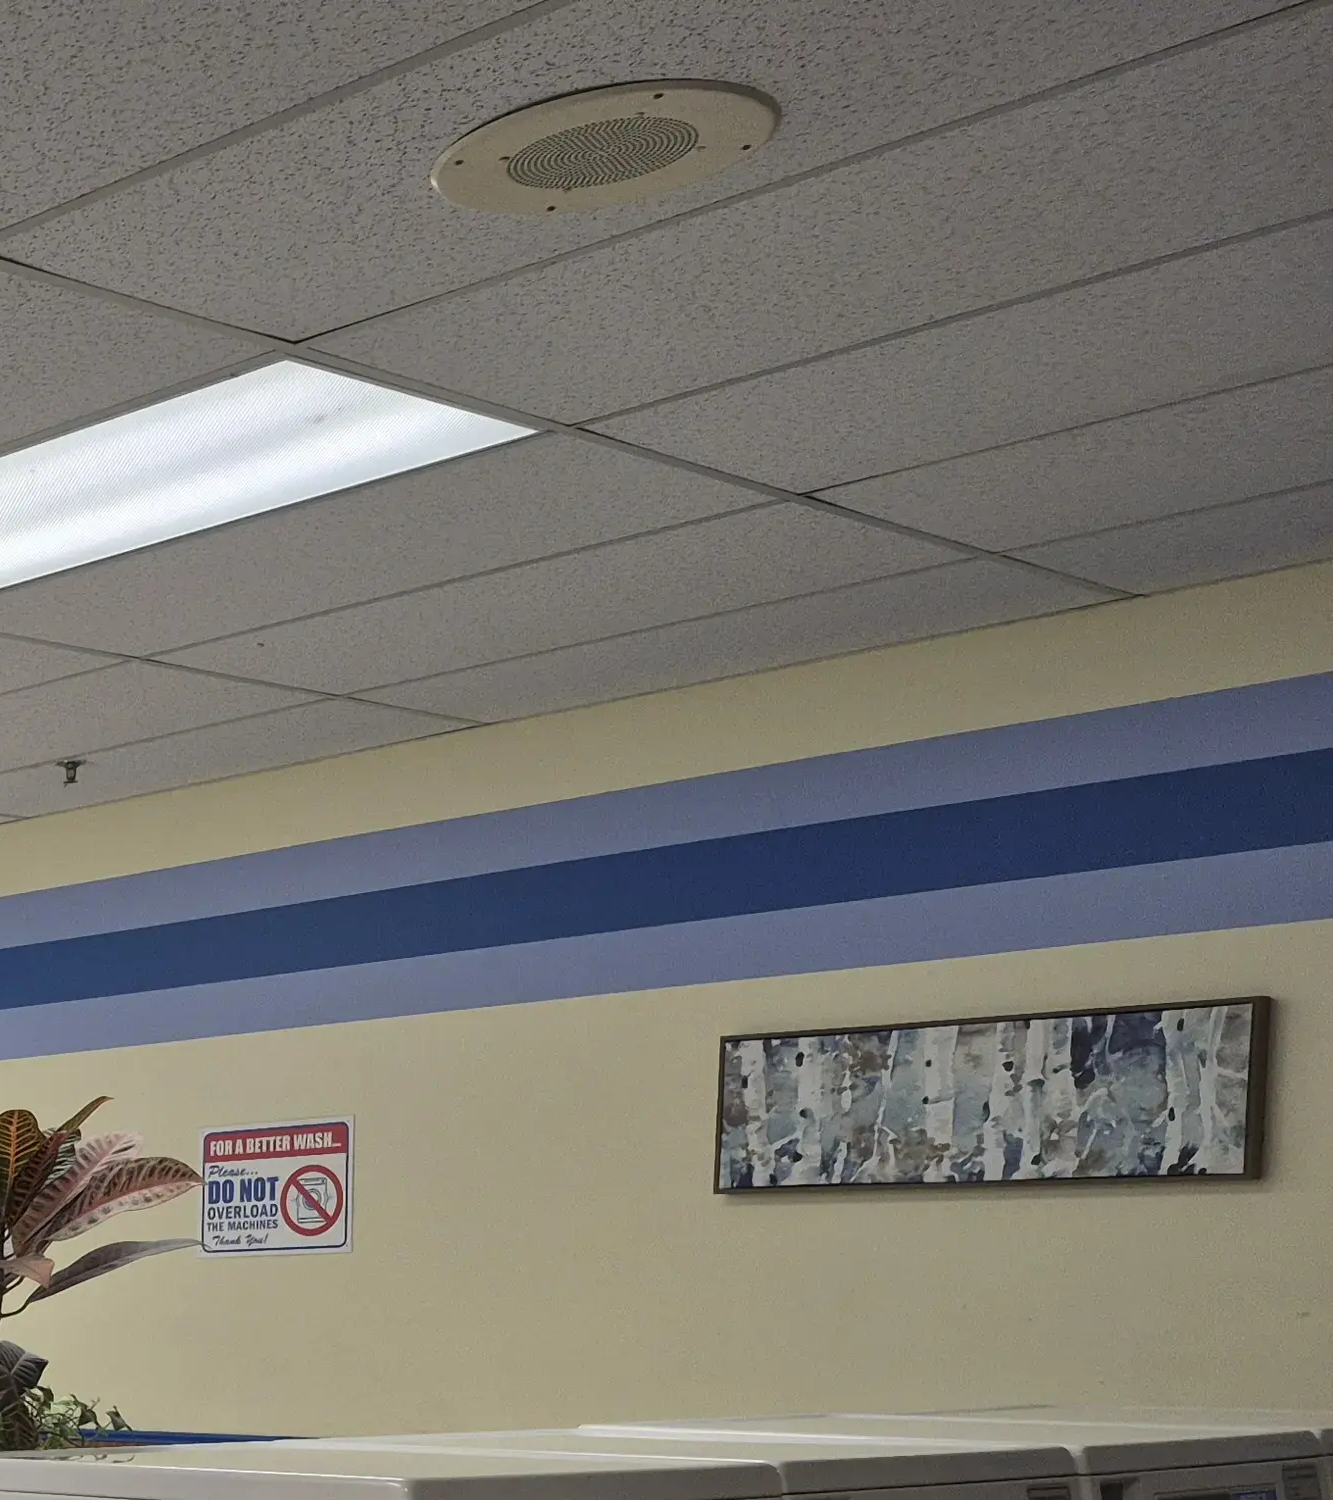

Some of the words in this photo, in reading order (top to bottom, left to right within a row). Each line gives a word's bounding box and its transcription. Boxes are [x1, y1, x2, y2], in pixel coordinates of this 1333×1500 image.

[210, 1139, 233, 1157] FOR
[235, 1138, 244, 1155] A
[246, 1135, 290, 1154] BETTER
[208, 1179, 234, 1204] DO
[240, 1176, 279, 1202] NOT
[207, 1204, 278, 1220] OVERLOAD
[207, 1221, 224, 1232] THE
[227, 1219, 278, 1231] MACHINES
[212, 1234, 241, 1247] Thank
